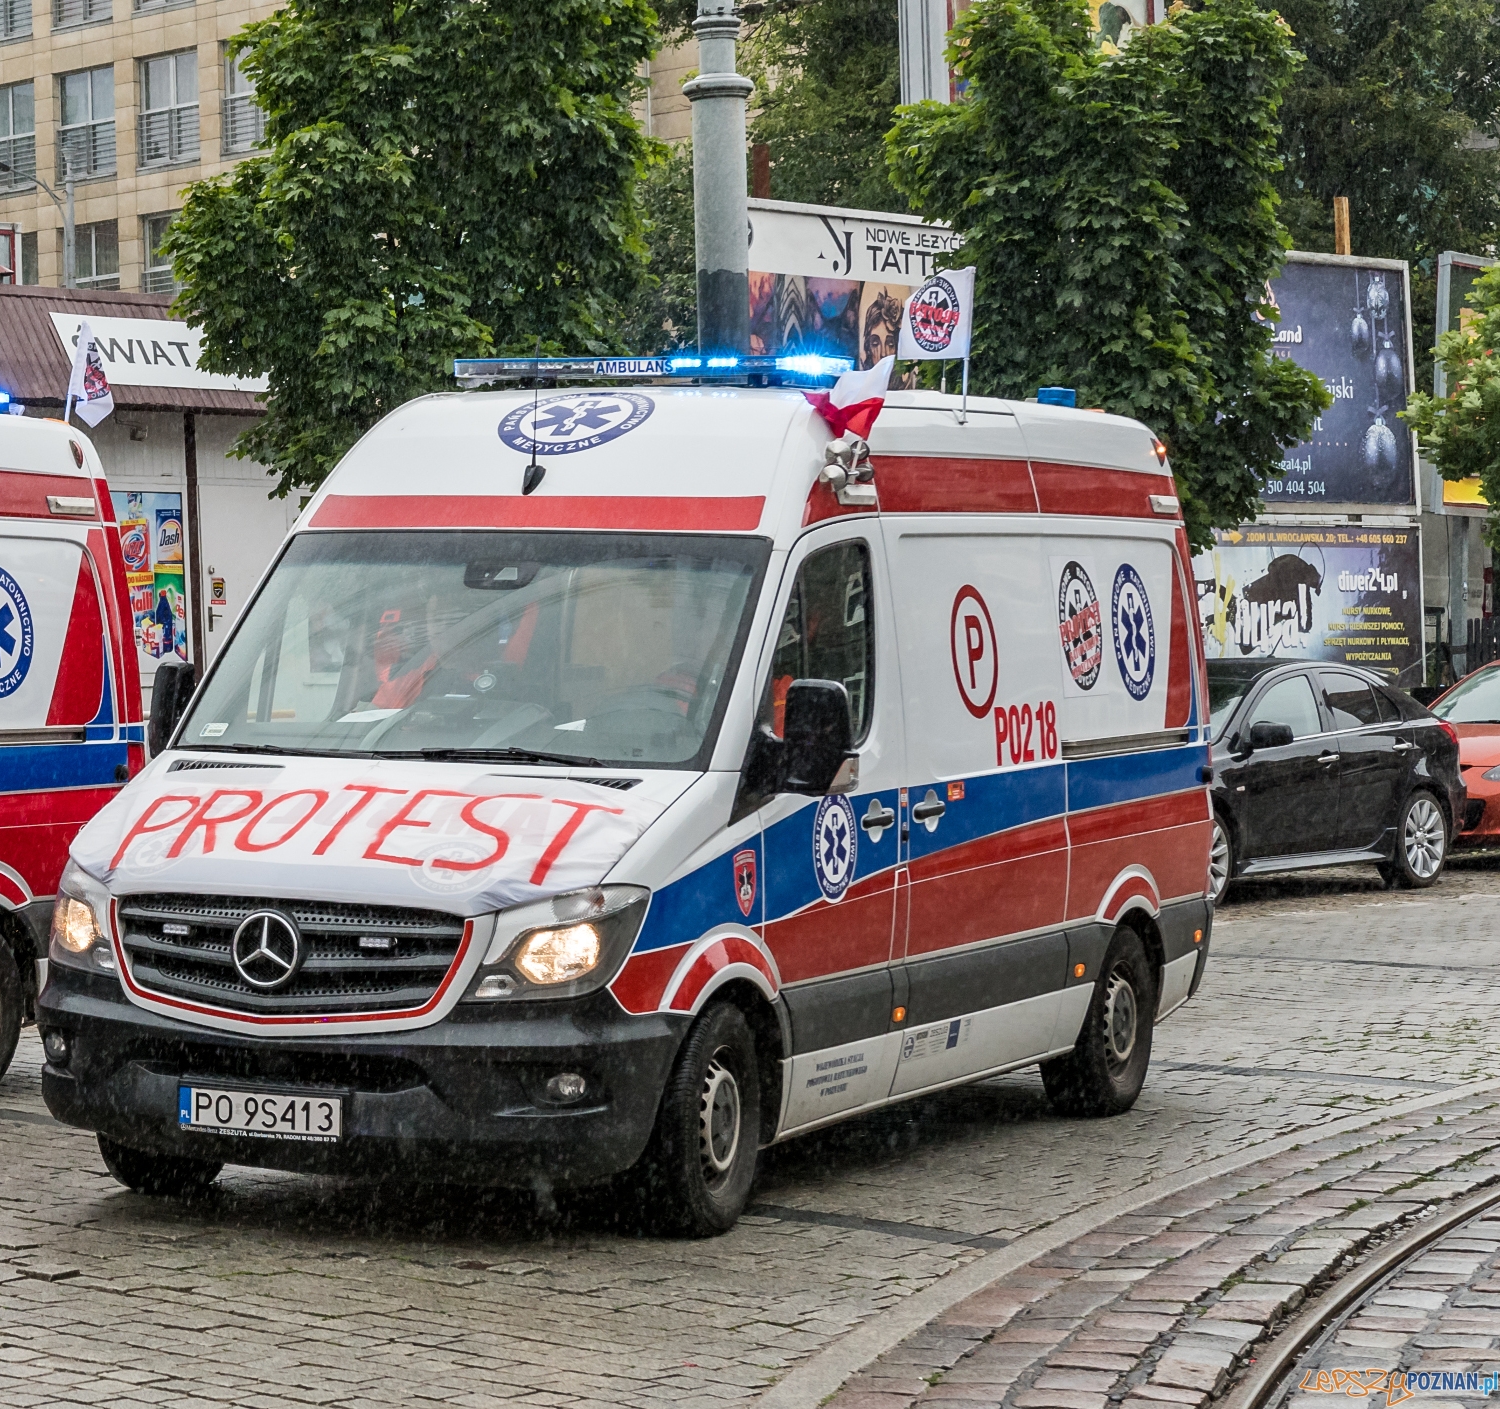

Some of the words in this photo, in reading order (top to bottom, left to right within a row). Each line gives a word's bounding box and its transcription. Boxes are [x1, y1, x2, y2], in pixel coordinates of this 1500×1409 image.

[866, 227, 910, 245] NOWE
[866, 245, 944, 276] TATT
[596, 360, 673, 373] AMBULANS
[512, 435, 602, 452] MEDYCZNE
[1268, 481, 1282, 494] 510
[1286, 481, 1304, 494] 404
[1308, 481, 1325, 495] 504
[159, 528, 179, 547] Dash
[1355, 534, 1368, 543] +48
[1369, 534, 1381, 543] 605
[1382, 534, 1394, 544] 660
[1395, 534, 1407, 544] 237
[1338, 567, 1398, 593] diver24.pl
[1347, 637, 1375, 646] NURKOWY
[964, 615, 983, 689] P
[1346, 651, 1392, 661] WYPOŻYCZALNIA
[1125, 672, 1151, 696] MEDYCZNE
[1036, 701, 1057, 760] 18
[109, 783, 624, 885] PROTEST
[181, 1110, 190, 1119] PL
[195, 1092, 233, 1124] PO
[244, 1097, 333, 1132] 9S413
